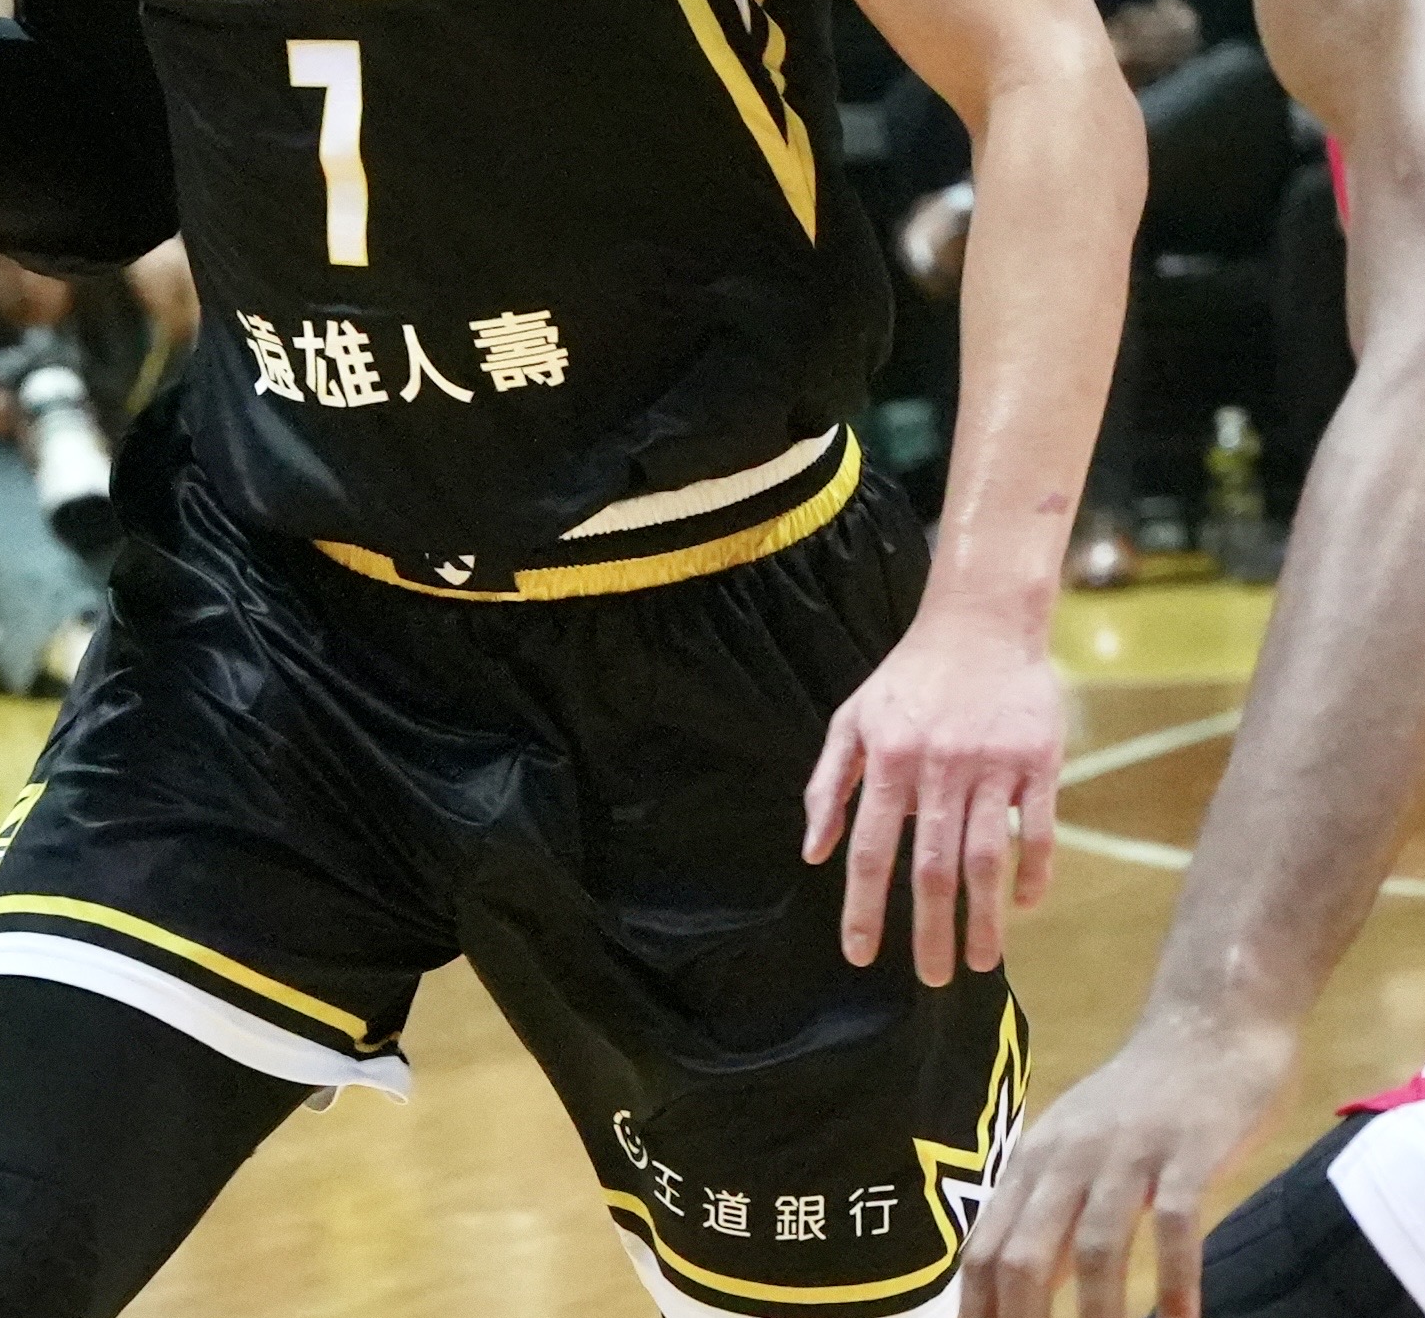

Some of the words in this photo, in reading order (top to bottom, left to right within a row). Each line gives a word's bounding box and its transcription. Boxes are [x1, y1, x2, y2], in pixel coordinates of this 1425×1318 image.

[286, 39, 369, 268] 7
[236, 309, 569, 408] 遠雄人壽
[652, 1160, 899, 1242] 王道銀行
